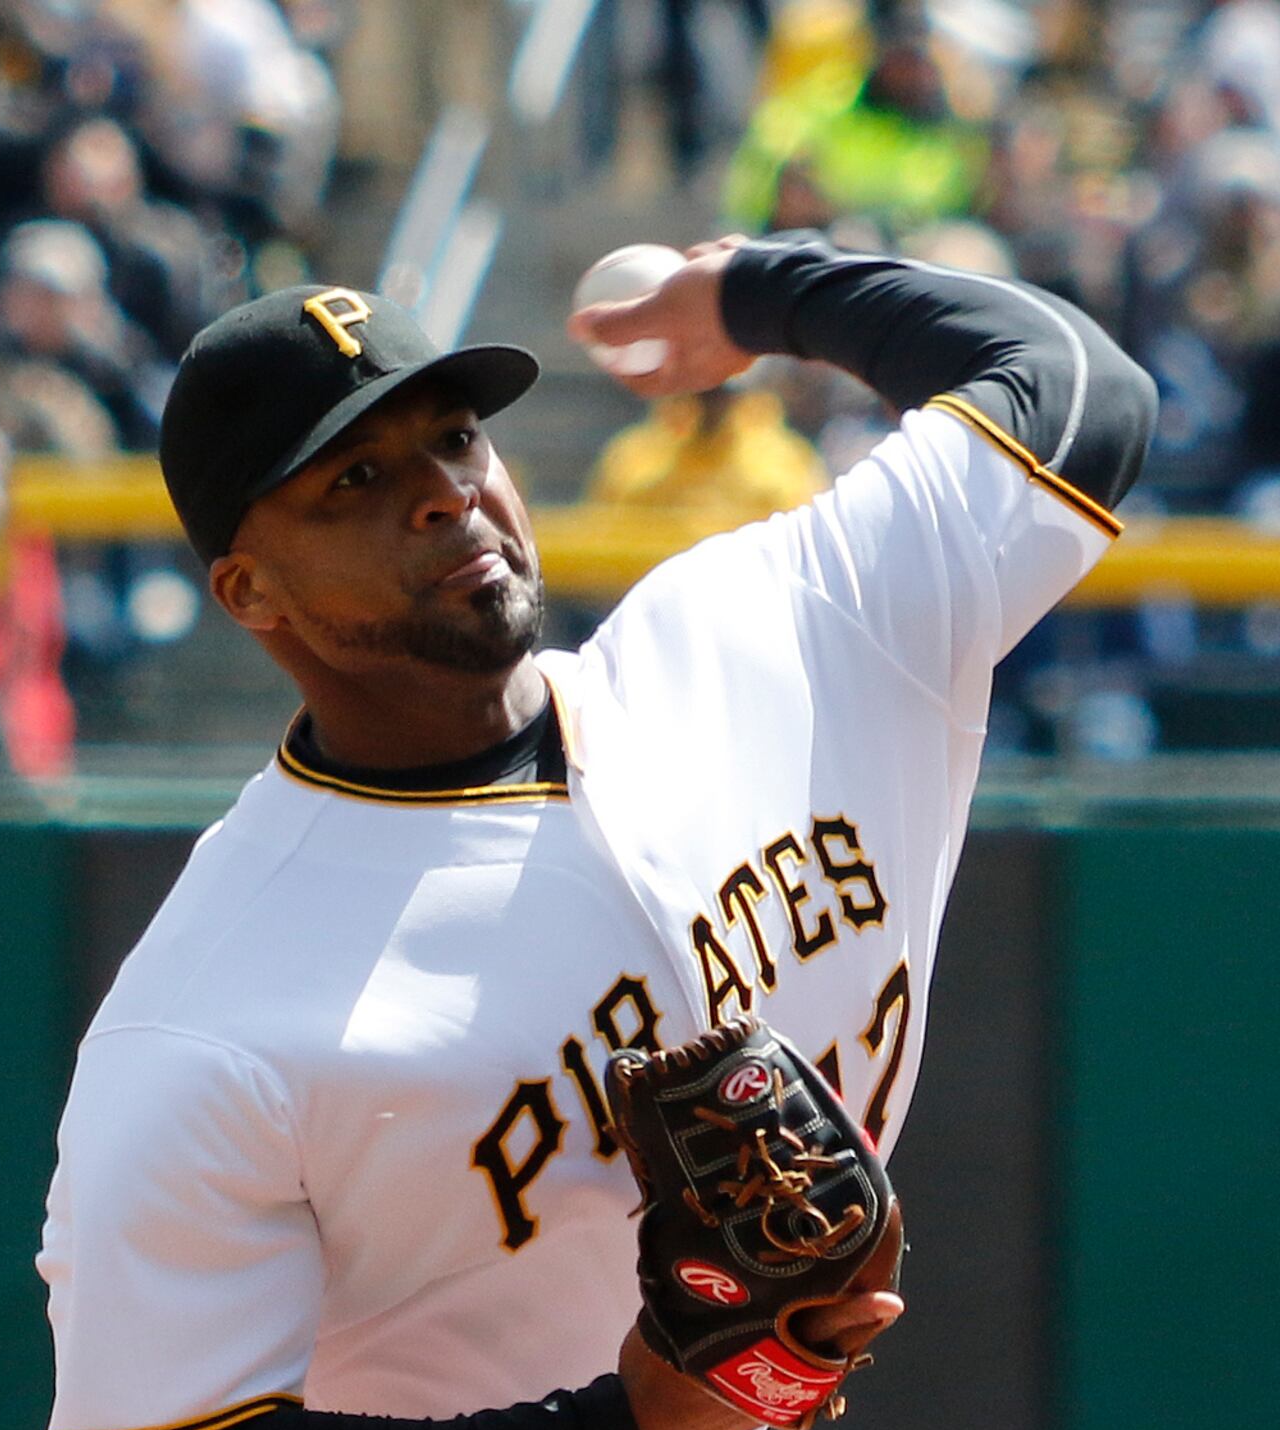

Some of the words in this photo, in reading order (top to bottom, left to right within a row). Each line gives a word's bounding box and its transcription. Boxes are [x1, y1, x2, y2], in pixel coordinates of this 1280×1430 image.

[304, 289, 373, 358] P
[815, 958, 912, 1152] 7
[724, 1066, 769, 1101] R
[679, 1265, 738, 1303] R
